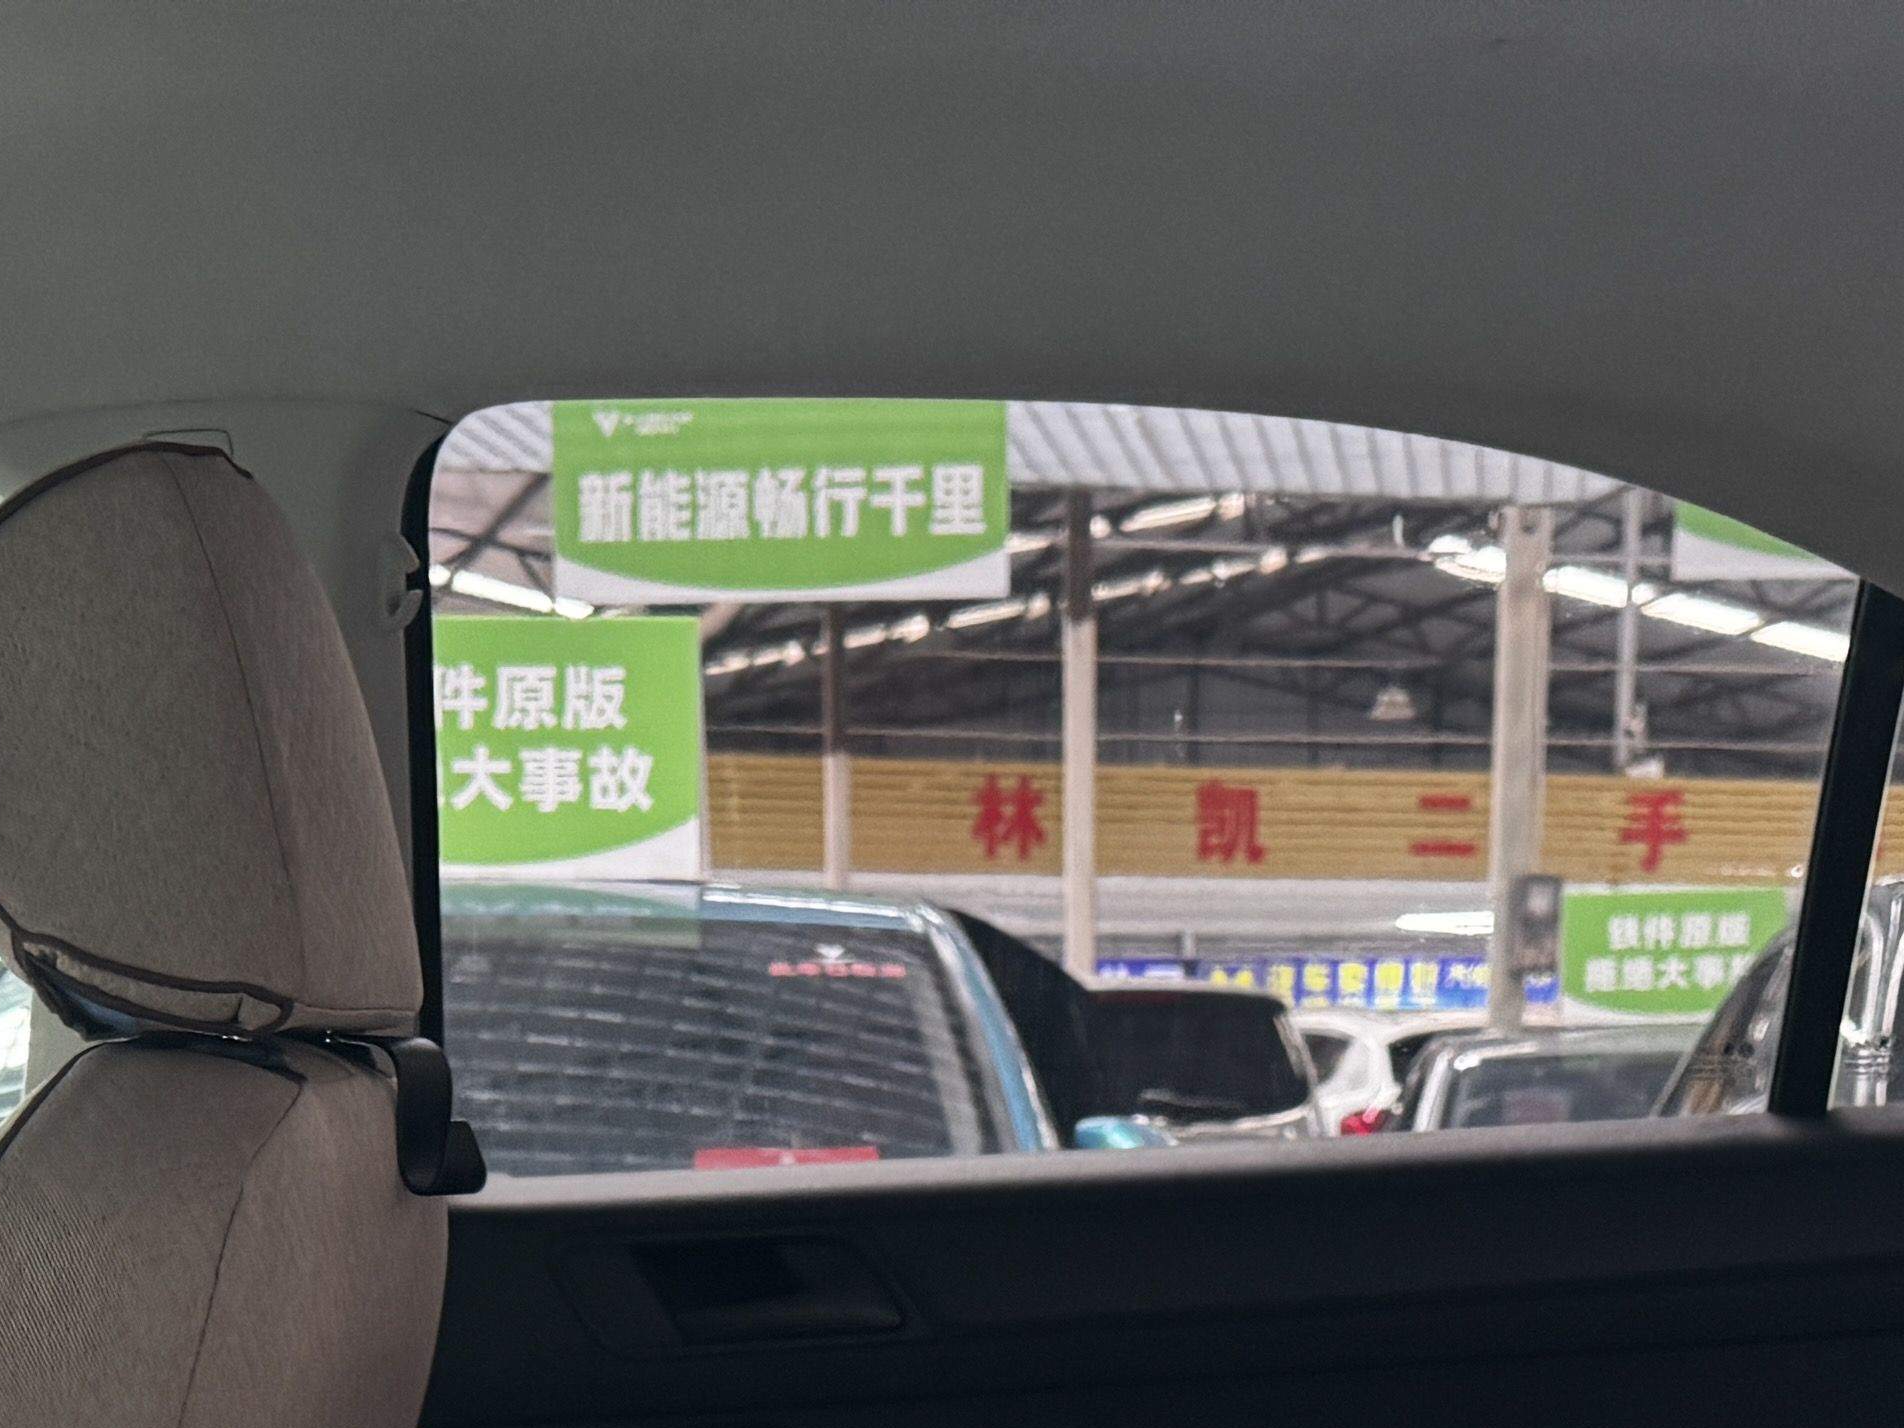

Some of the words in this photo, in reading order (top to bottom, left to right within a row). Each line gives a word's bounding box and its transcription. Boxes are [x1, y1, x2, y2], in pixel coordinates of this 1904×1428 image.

[577, 462, 988, 543] 新能源畅行千里
[450, 742, 654, 813] 大事故
